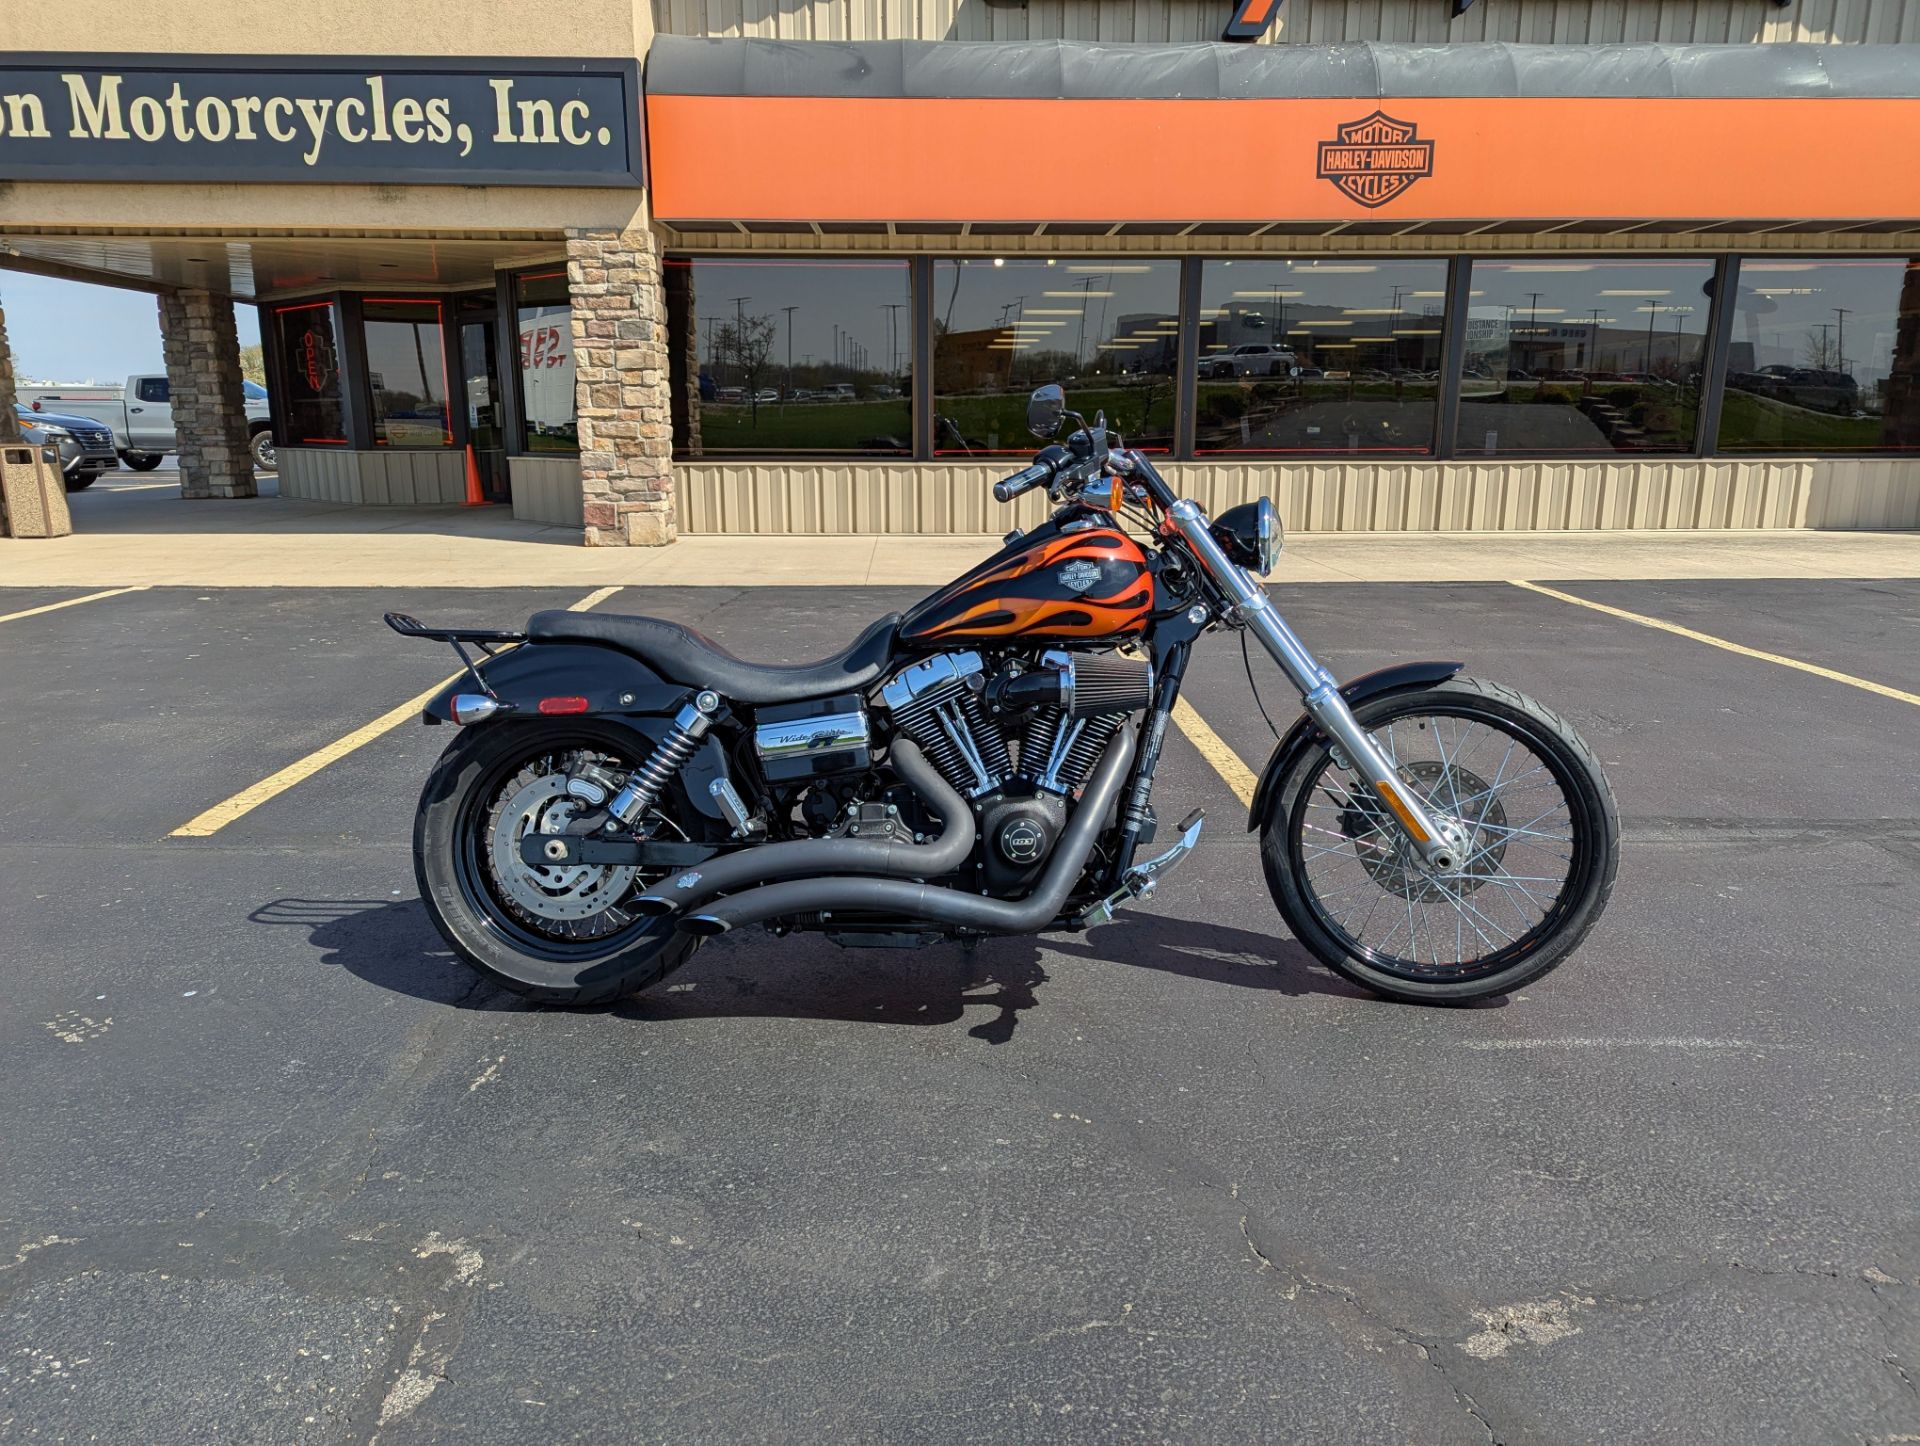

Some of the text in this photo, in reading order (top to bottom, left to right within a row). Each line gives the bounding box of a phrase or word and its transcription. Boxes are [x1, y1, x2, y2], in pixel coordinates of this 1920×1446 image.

[0, 74, 611, 166] n Motorcycles, Inc.
[1351, 122, 1403, 143] MOTOR
[1326, 149, 1425, 170] HARLEY-DAVIDSON
[1347, 175, 1400, 199] CYCLES
[305, 332, 320, 389] OPEN
